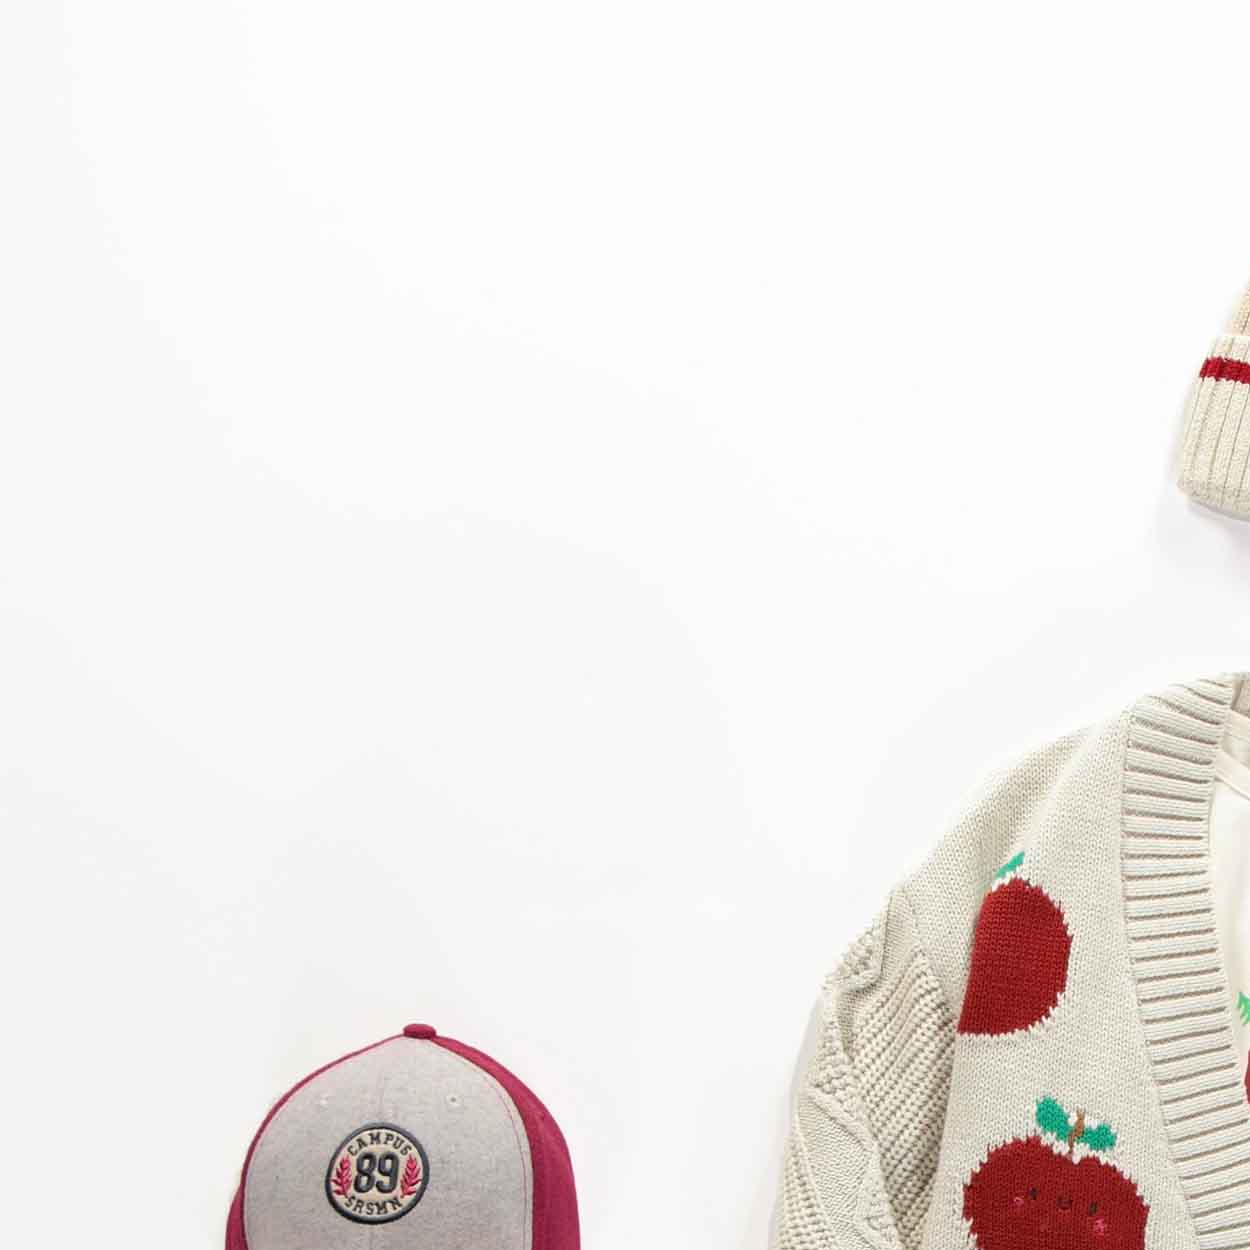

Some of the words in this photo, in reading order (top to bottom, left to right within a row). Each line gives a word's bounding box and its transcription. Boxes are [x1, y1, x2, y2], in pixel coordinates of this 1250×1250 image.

[347, 1131, 412, 1156] CAMPUS
[354, 1152, 399, 1193] 89
[344, 1195, 403, 1216] SRSMN
